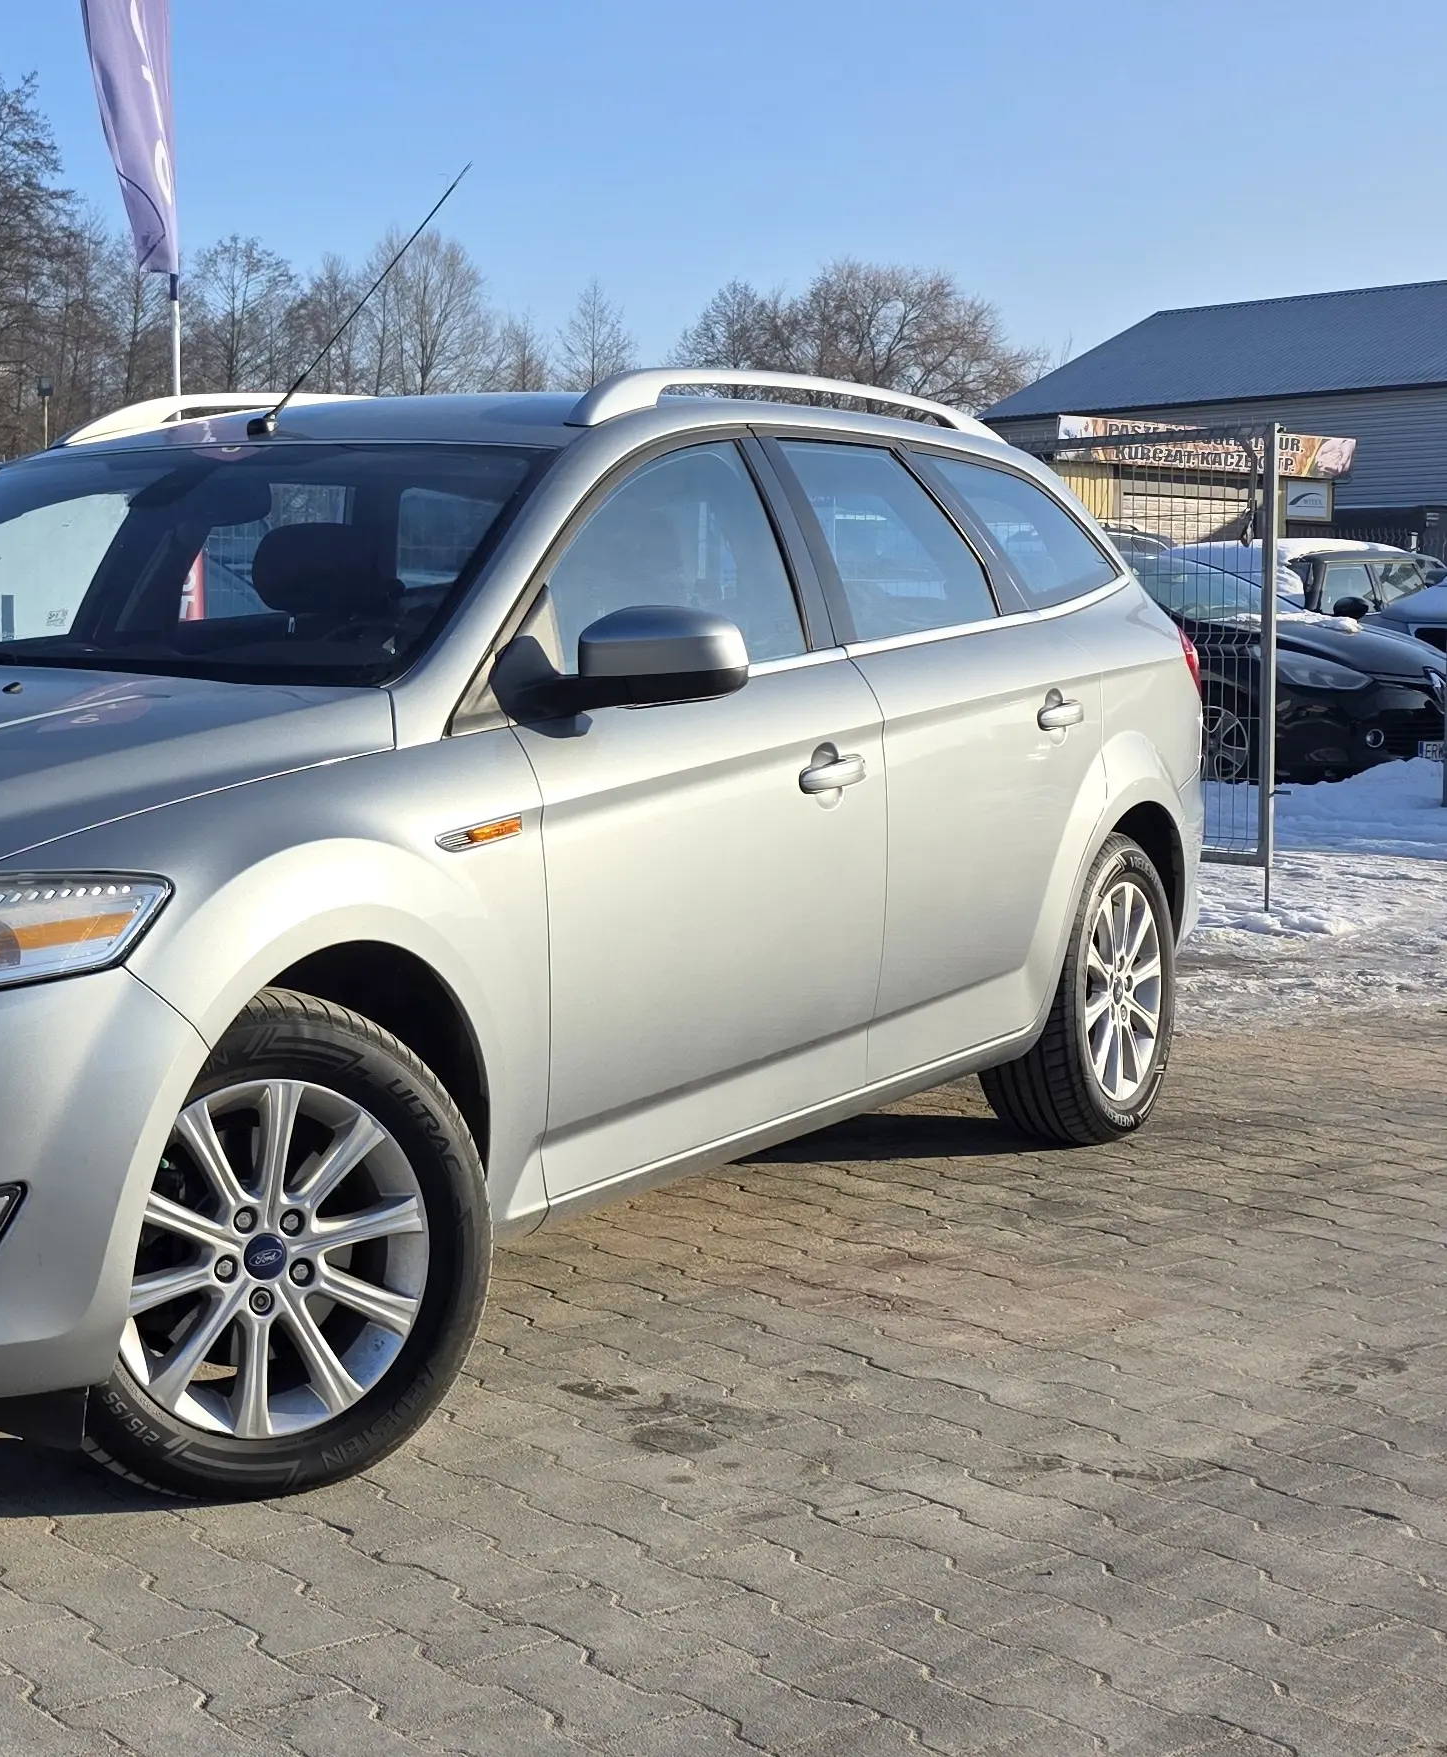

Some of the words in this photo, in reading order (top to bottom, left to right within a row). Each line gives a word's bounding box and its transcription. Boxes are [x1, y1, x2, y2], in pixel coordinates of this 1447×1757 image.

[386, 1078, 463, 1177] ULTRAC
[255, 1251, 277, 1265] Ford
[102, 1391, 160, 1446] 215/55
